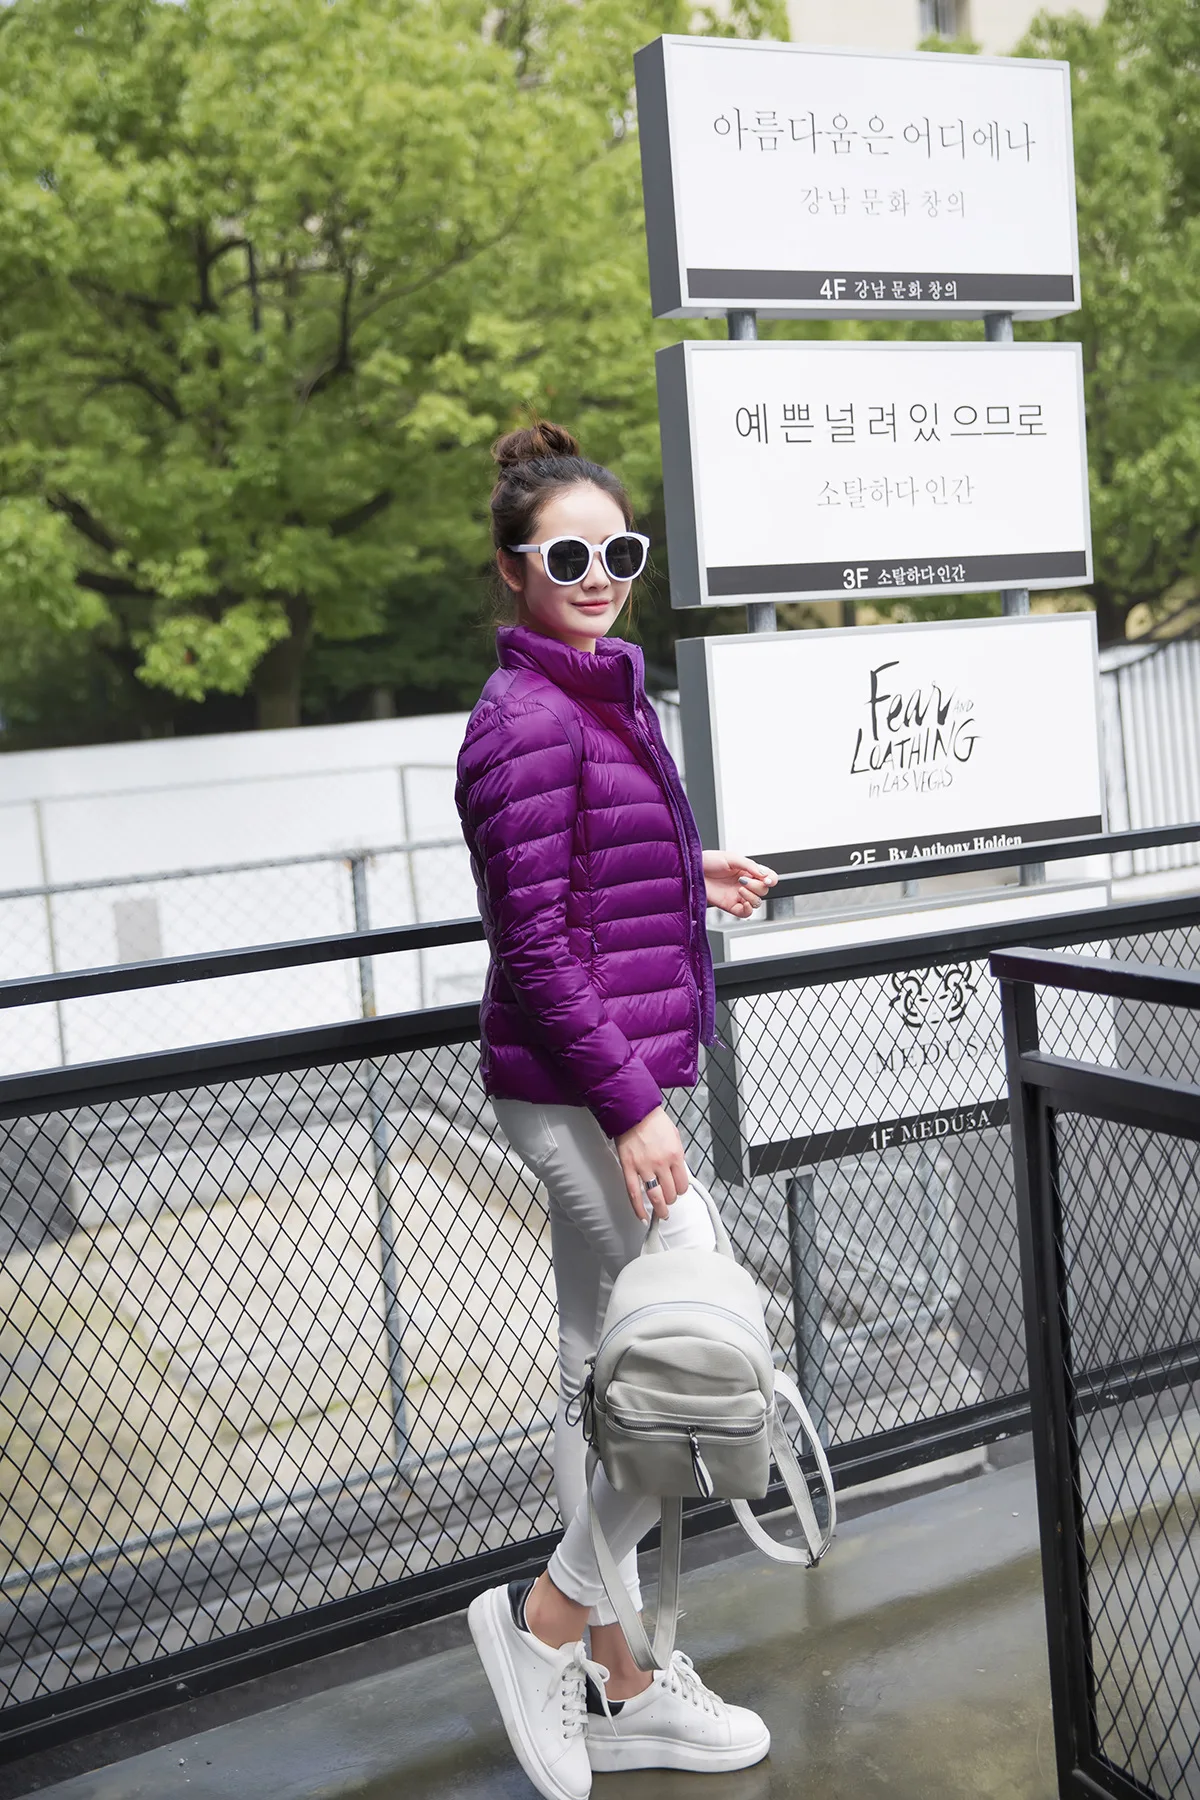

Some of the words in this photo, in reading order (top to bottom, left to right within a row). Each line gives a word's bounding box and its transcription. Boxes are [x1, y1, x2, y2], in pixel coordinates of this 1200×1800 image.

[800, 185, 850, 216] 강남
[860, 188, 910, 217] 문화
[819, 277, 847, 300] 4F
[854, 279, 887, 300] 강남
[891, 280, 923, 300] 문화
[928, 280, 958, 301] 창의
[842, 567, 869, 590] 3F
[863, 660, 956, 741] Fear
[850, 717, 983, 775] LOATHING
[868, 775, 880, 799] in
[882, 771, 910, 793] LAS
[912, 765, 953, 793] VEGAS
[911, 841, 971, 859] Anthony
[972, 833, 1023, 851] Holden
[872, 1034, 998, 1075] MEDUSA
[870, 1127, 895, 1150] 1F
[900, 1109, 992, 1143] MEDUSA
